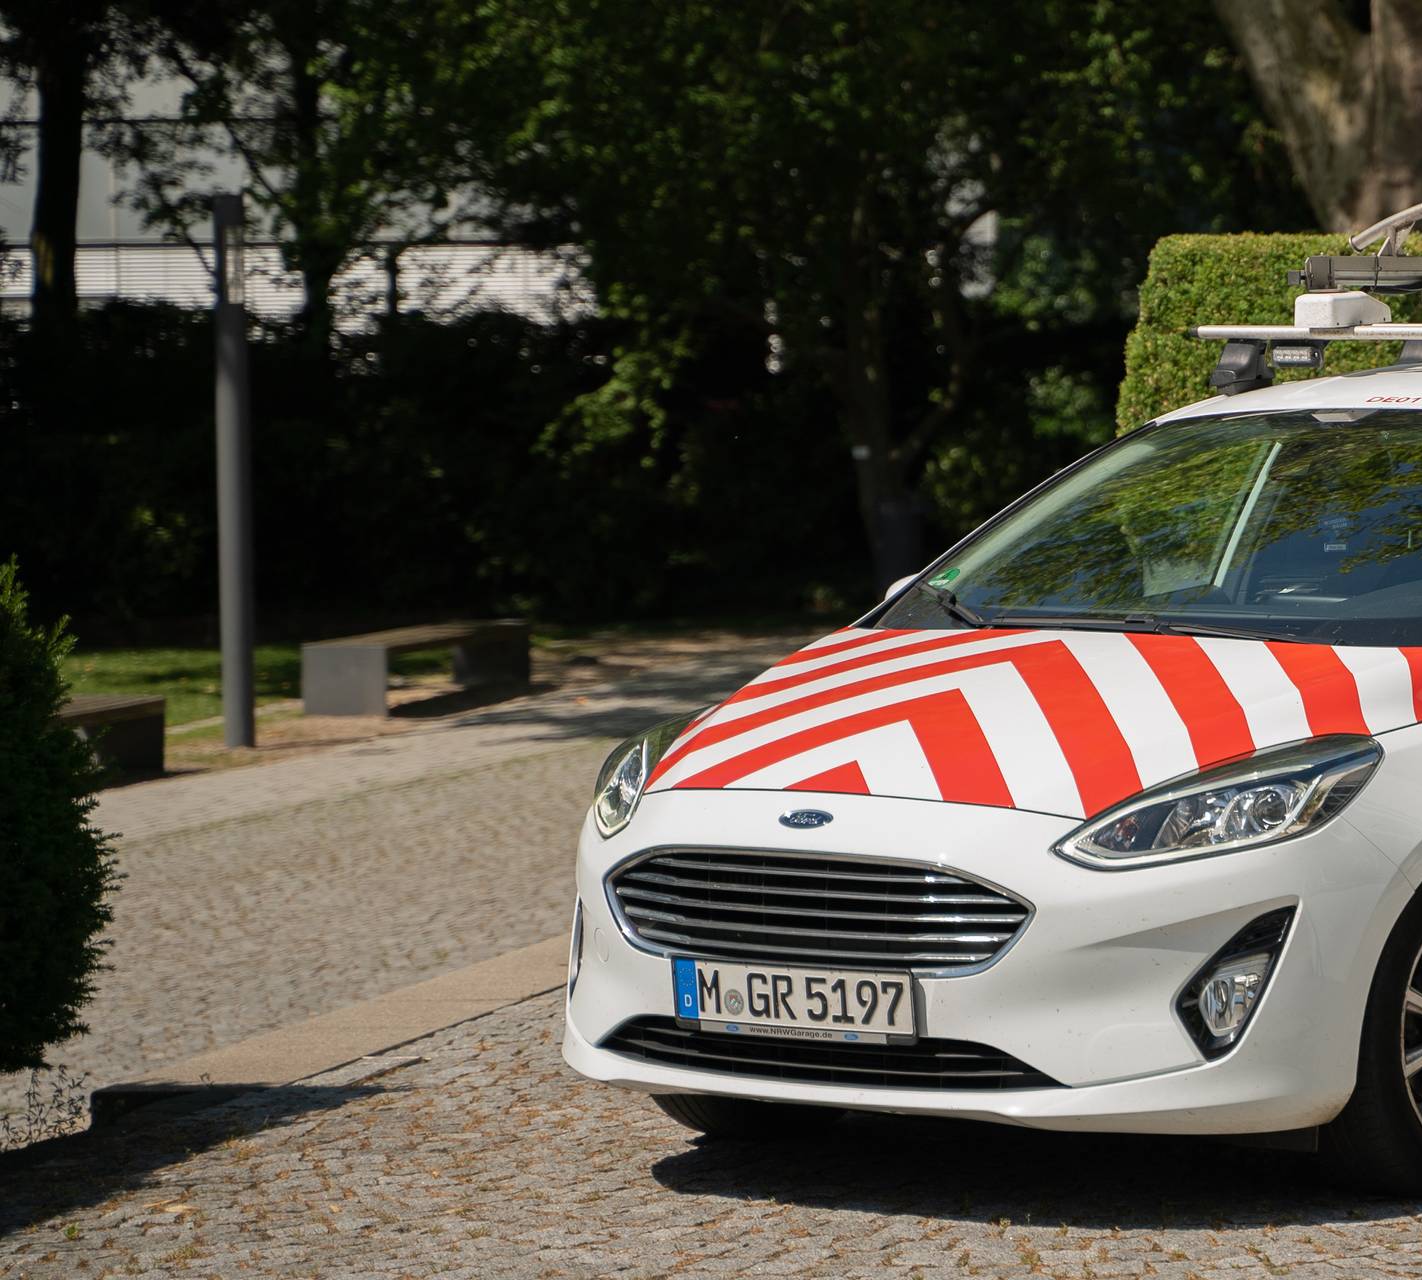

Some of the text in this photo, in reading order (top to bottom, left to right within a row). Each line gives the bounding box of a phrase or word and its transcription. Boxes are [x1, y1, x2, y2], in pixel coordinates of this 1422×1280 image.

[684, 968, 904, 1027] D M GR 5197
[749, 1026, 833, 1040] www.NRWGarage.de
